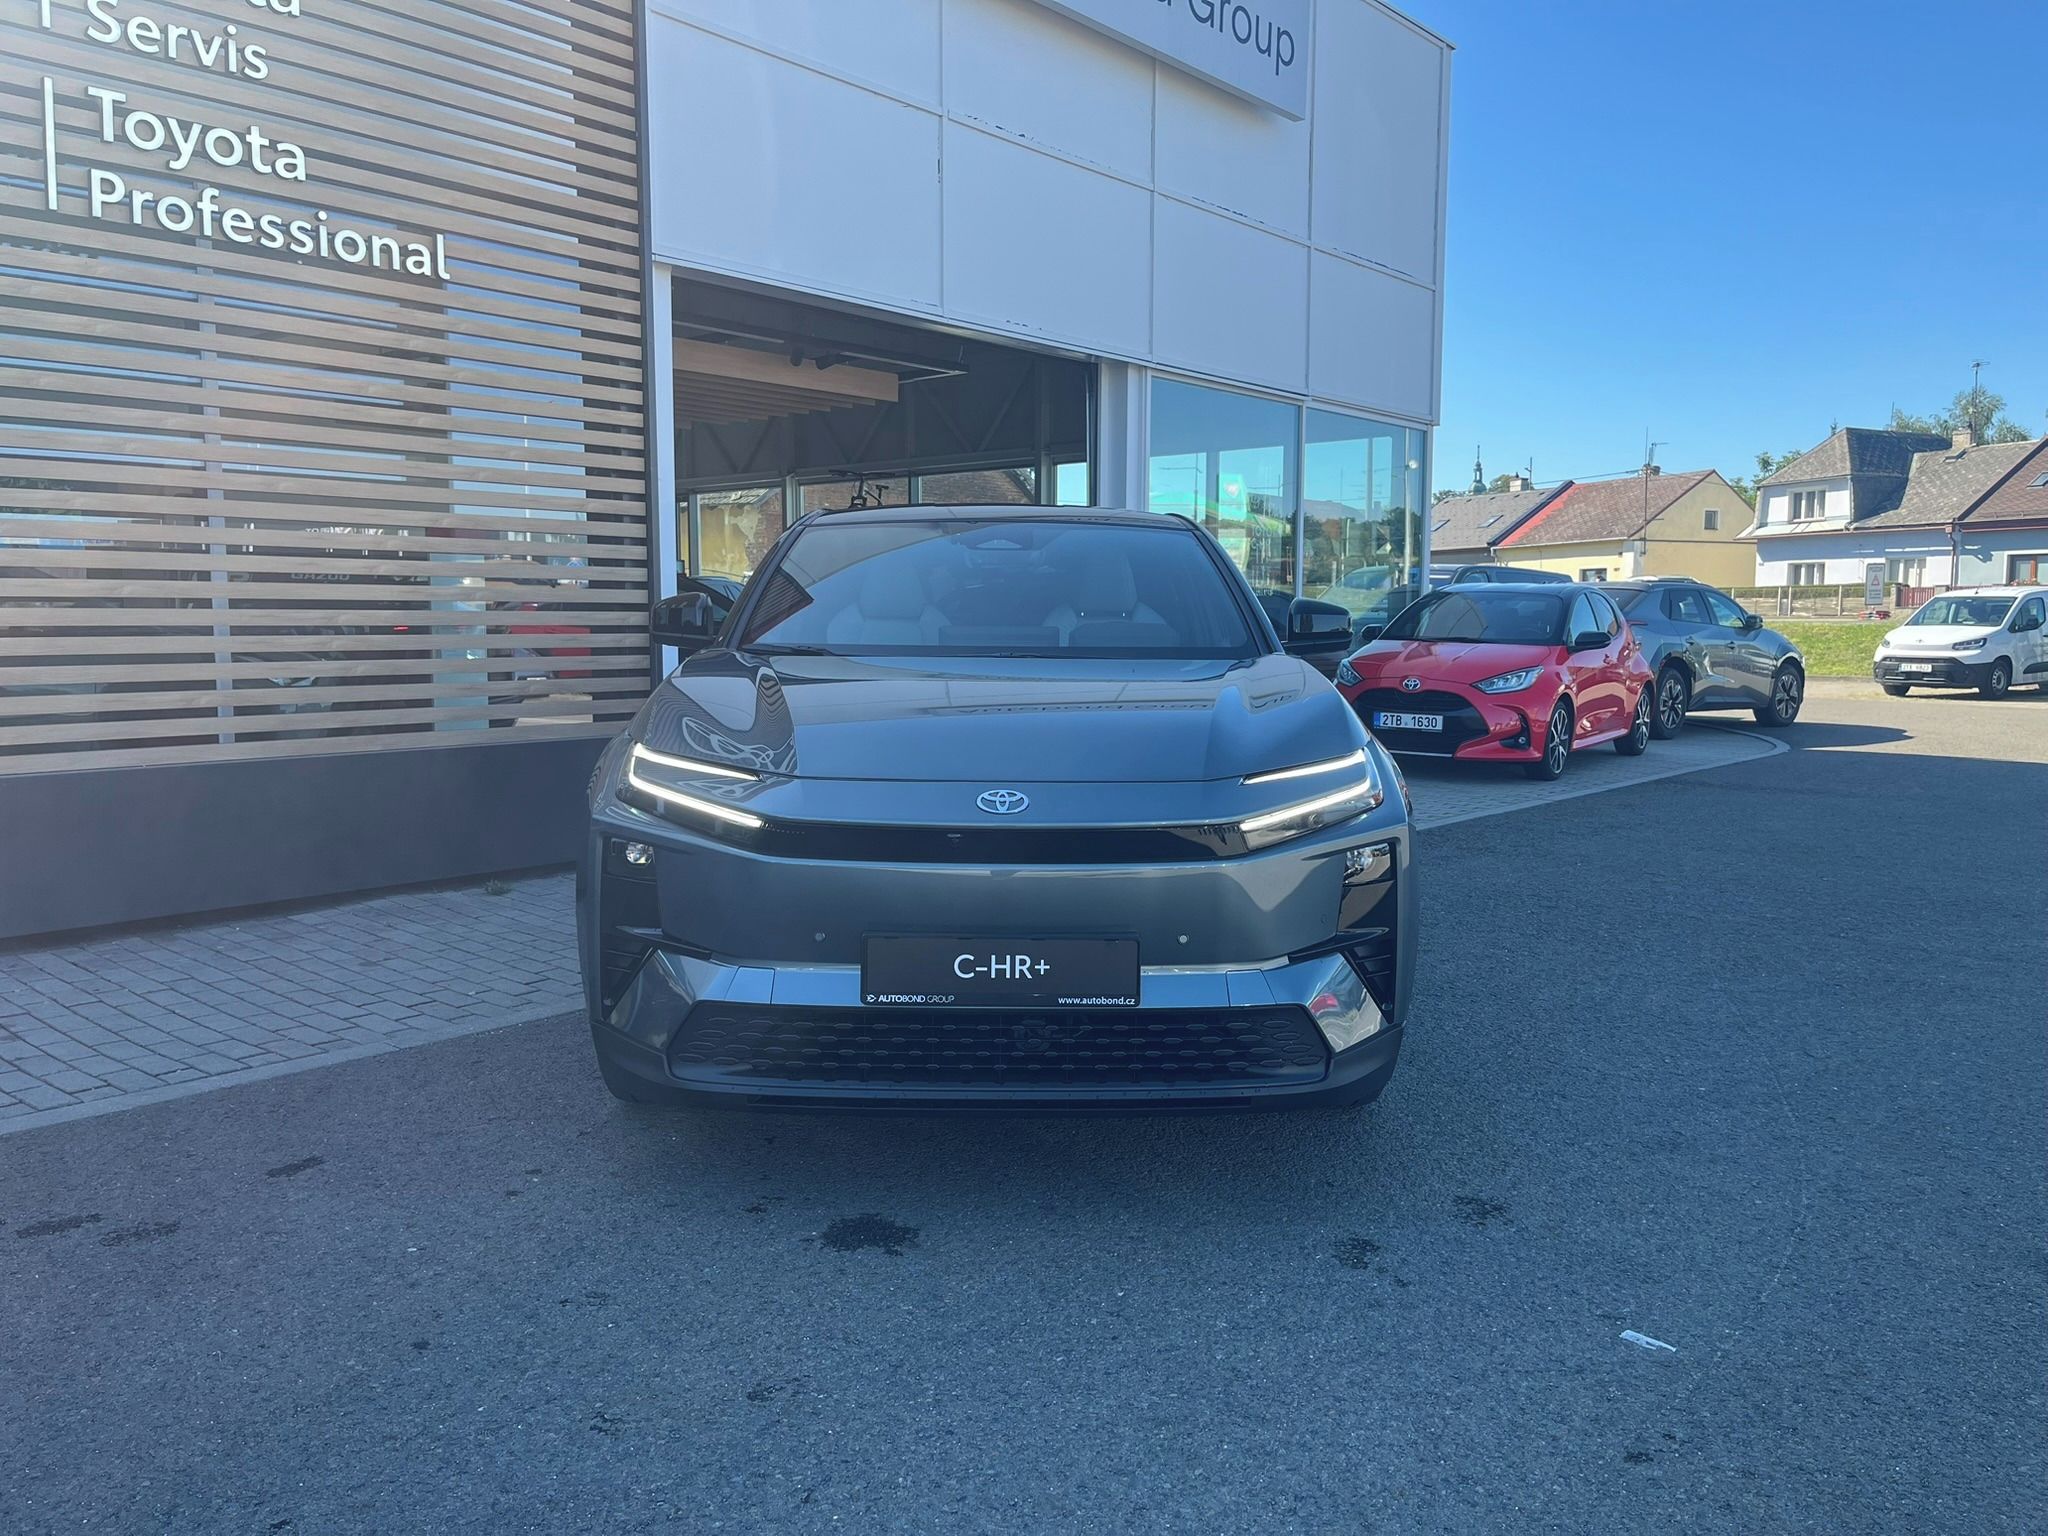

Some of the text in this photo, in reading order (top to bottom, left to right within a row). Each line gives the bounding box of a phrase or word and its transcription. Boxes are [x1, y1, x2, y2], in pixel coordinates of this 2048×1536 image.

[86, 0, 270, 80] Servis
[87, 86, 307, 181] Toyota
[89, 168, 450, 280] Professional
[1382, 714, 1402, 726] 2TB
[1411, 716, 1438, 728] 1630
[953, 954, 1050, 979] C-HR+
[878, 994, 955, 1004] AUTOBOND GROUP
[1058, 995, 1136, 1005] www.autobond.cz
